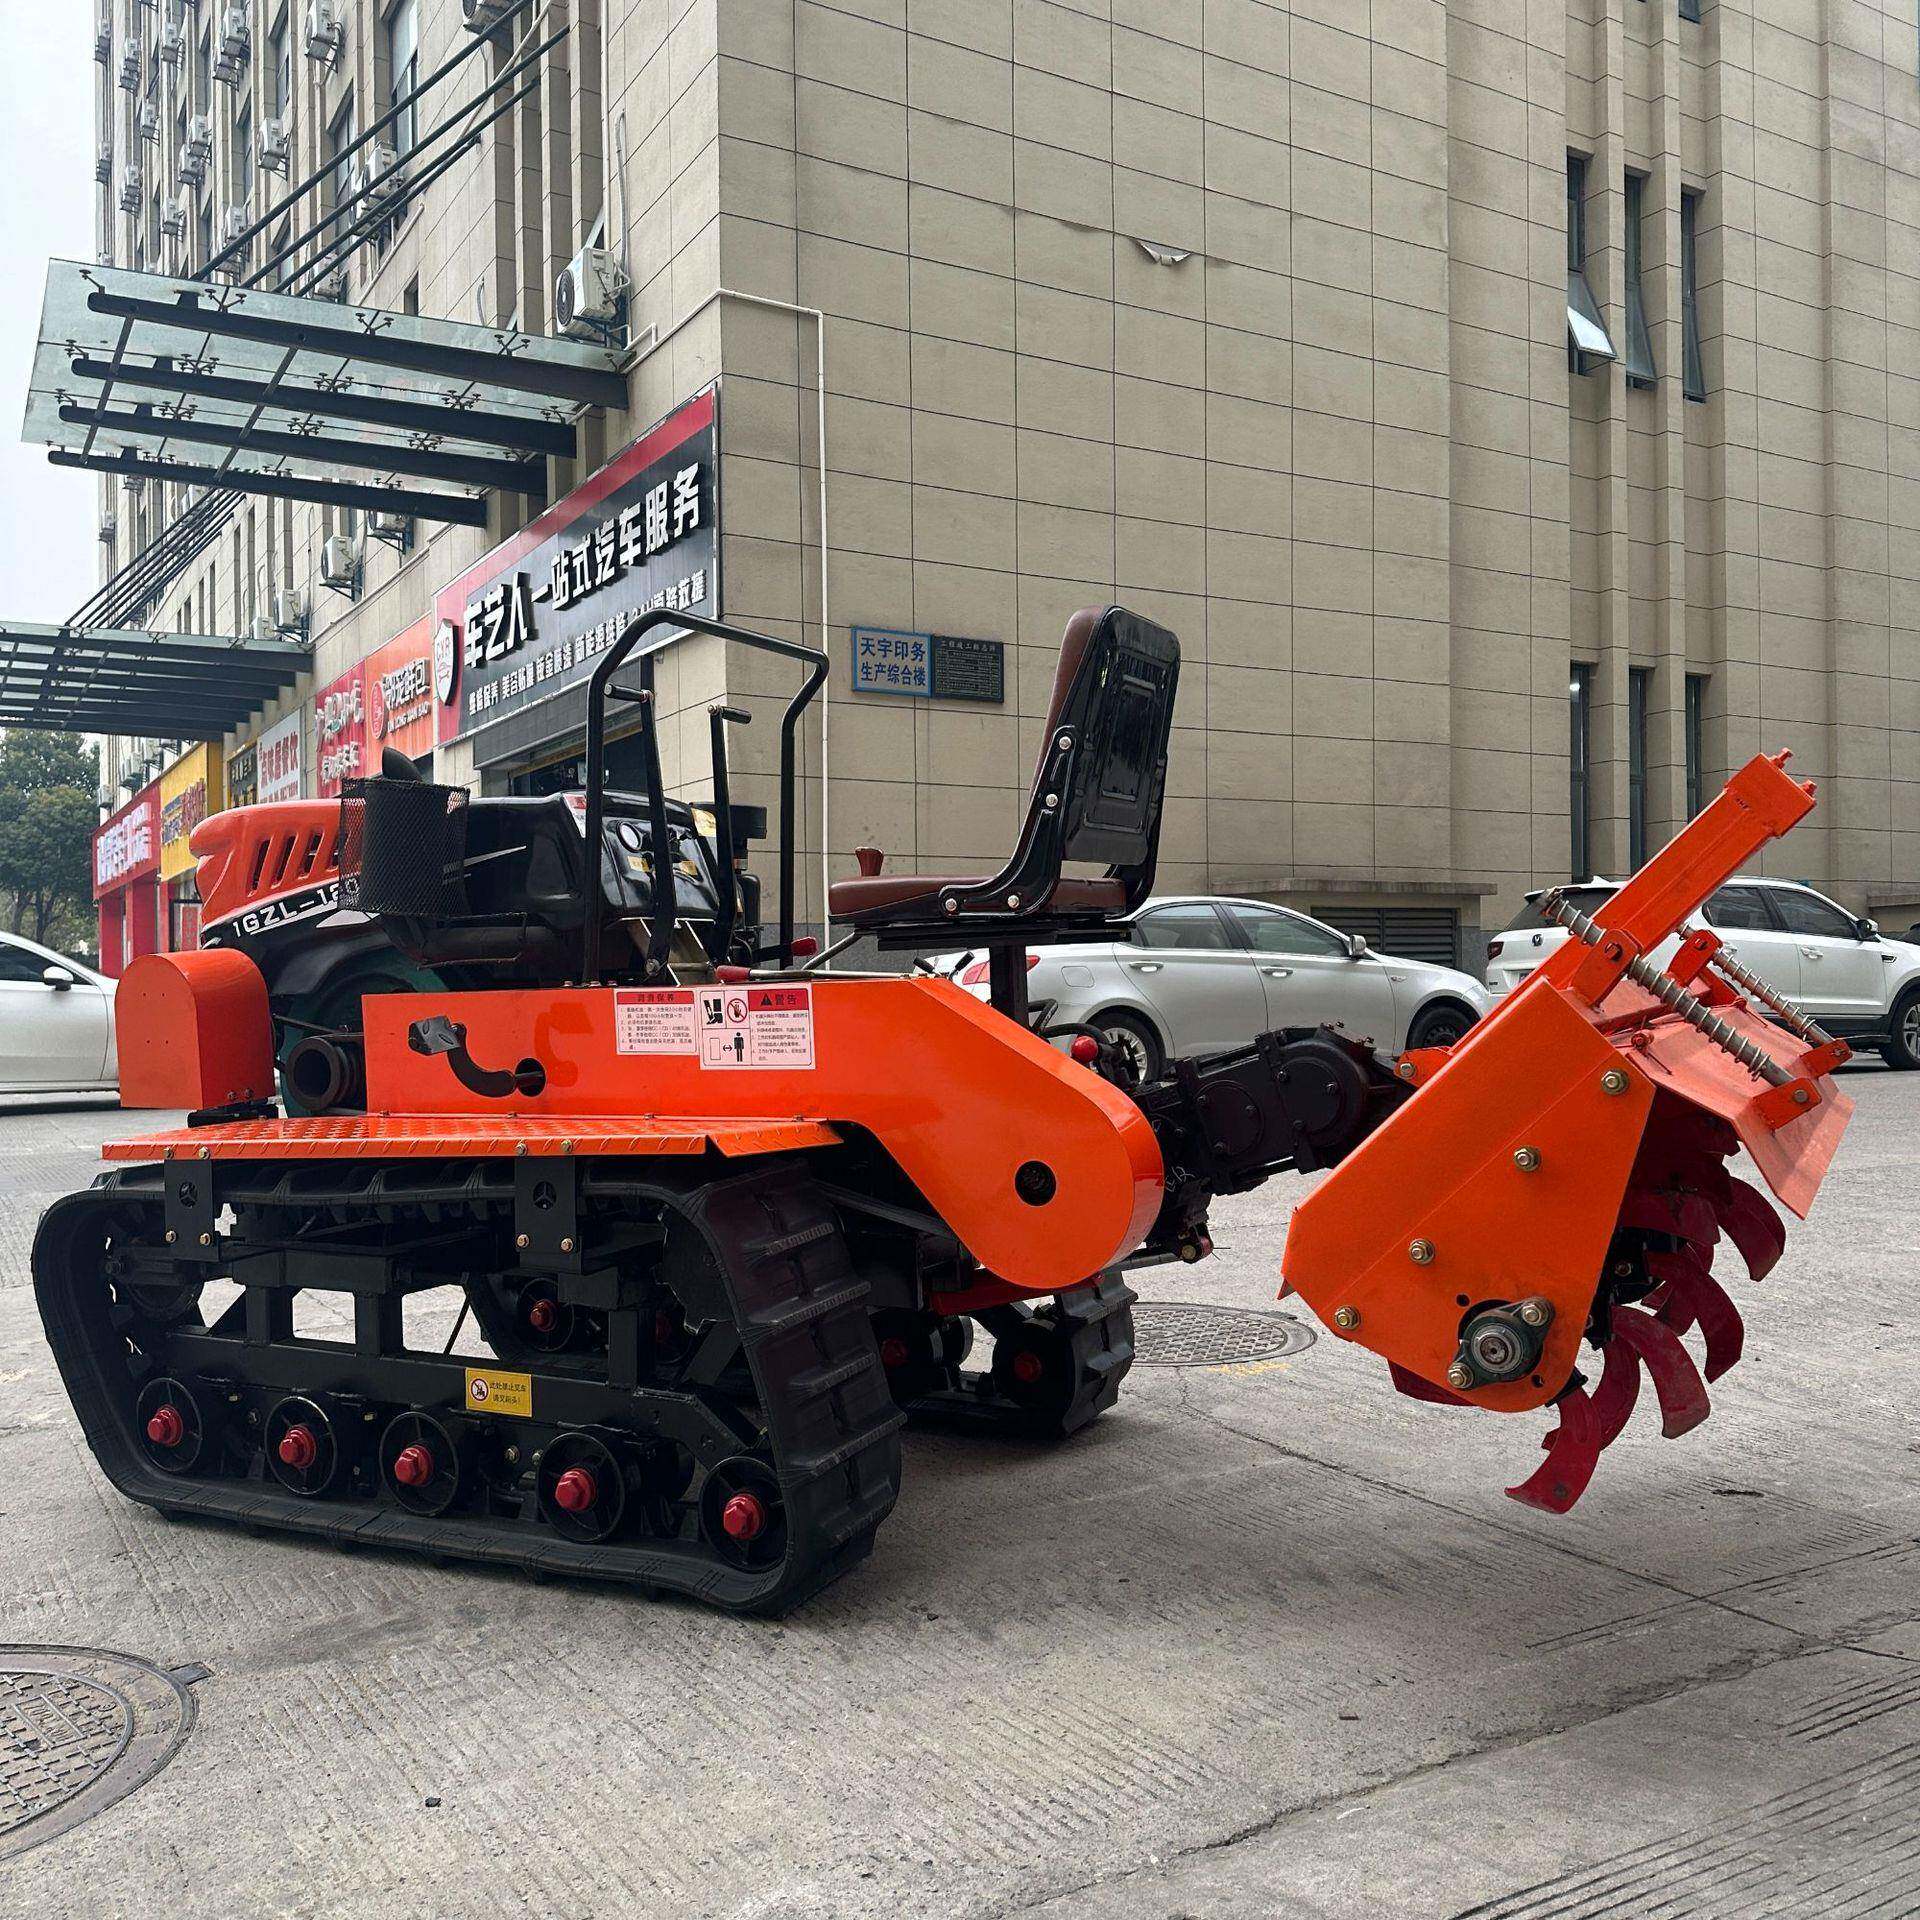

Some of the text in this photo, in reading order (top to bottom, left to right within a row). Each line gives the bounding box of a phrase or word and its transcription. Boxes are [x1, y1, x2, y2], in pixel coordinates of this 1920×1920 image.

[860, 637, 926, 662] 天宇印务
[860, 661, 926, 687] 生产综合楼
